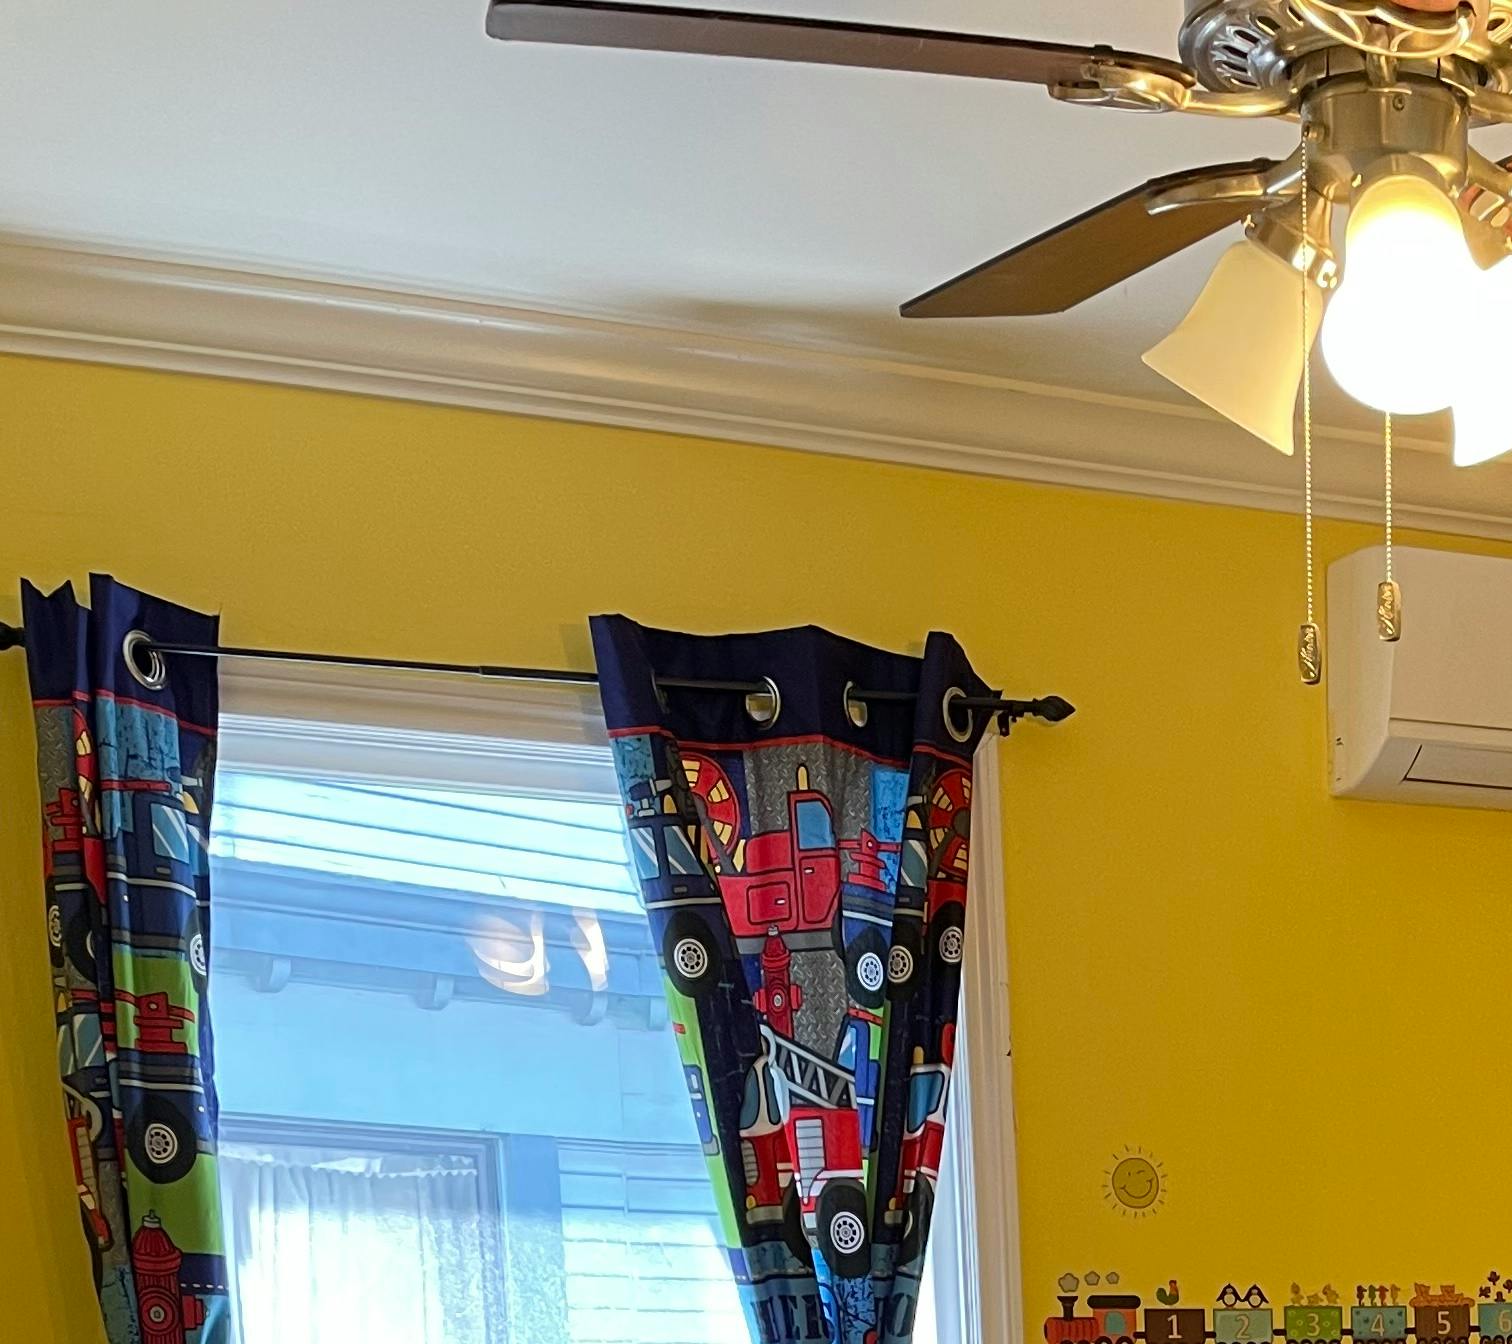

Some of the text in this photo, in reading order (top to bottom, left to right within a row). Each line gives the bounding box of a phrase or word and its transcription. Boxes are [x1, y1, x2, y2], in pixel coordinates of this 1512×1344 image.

[1167, 1314, 1182, 1339] 1
[1235, 1315, 1250, 1340] 2
[1306, 1313, 1321, 1337] 3
[1370, 1312, 1385, 1337] 4
[1437, 1310, 1451, 1335] 5
[1498, 1310, 1512, 1334] 6
